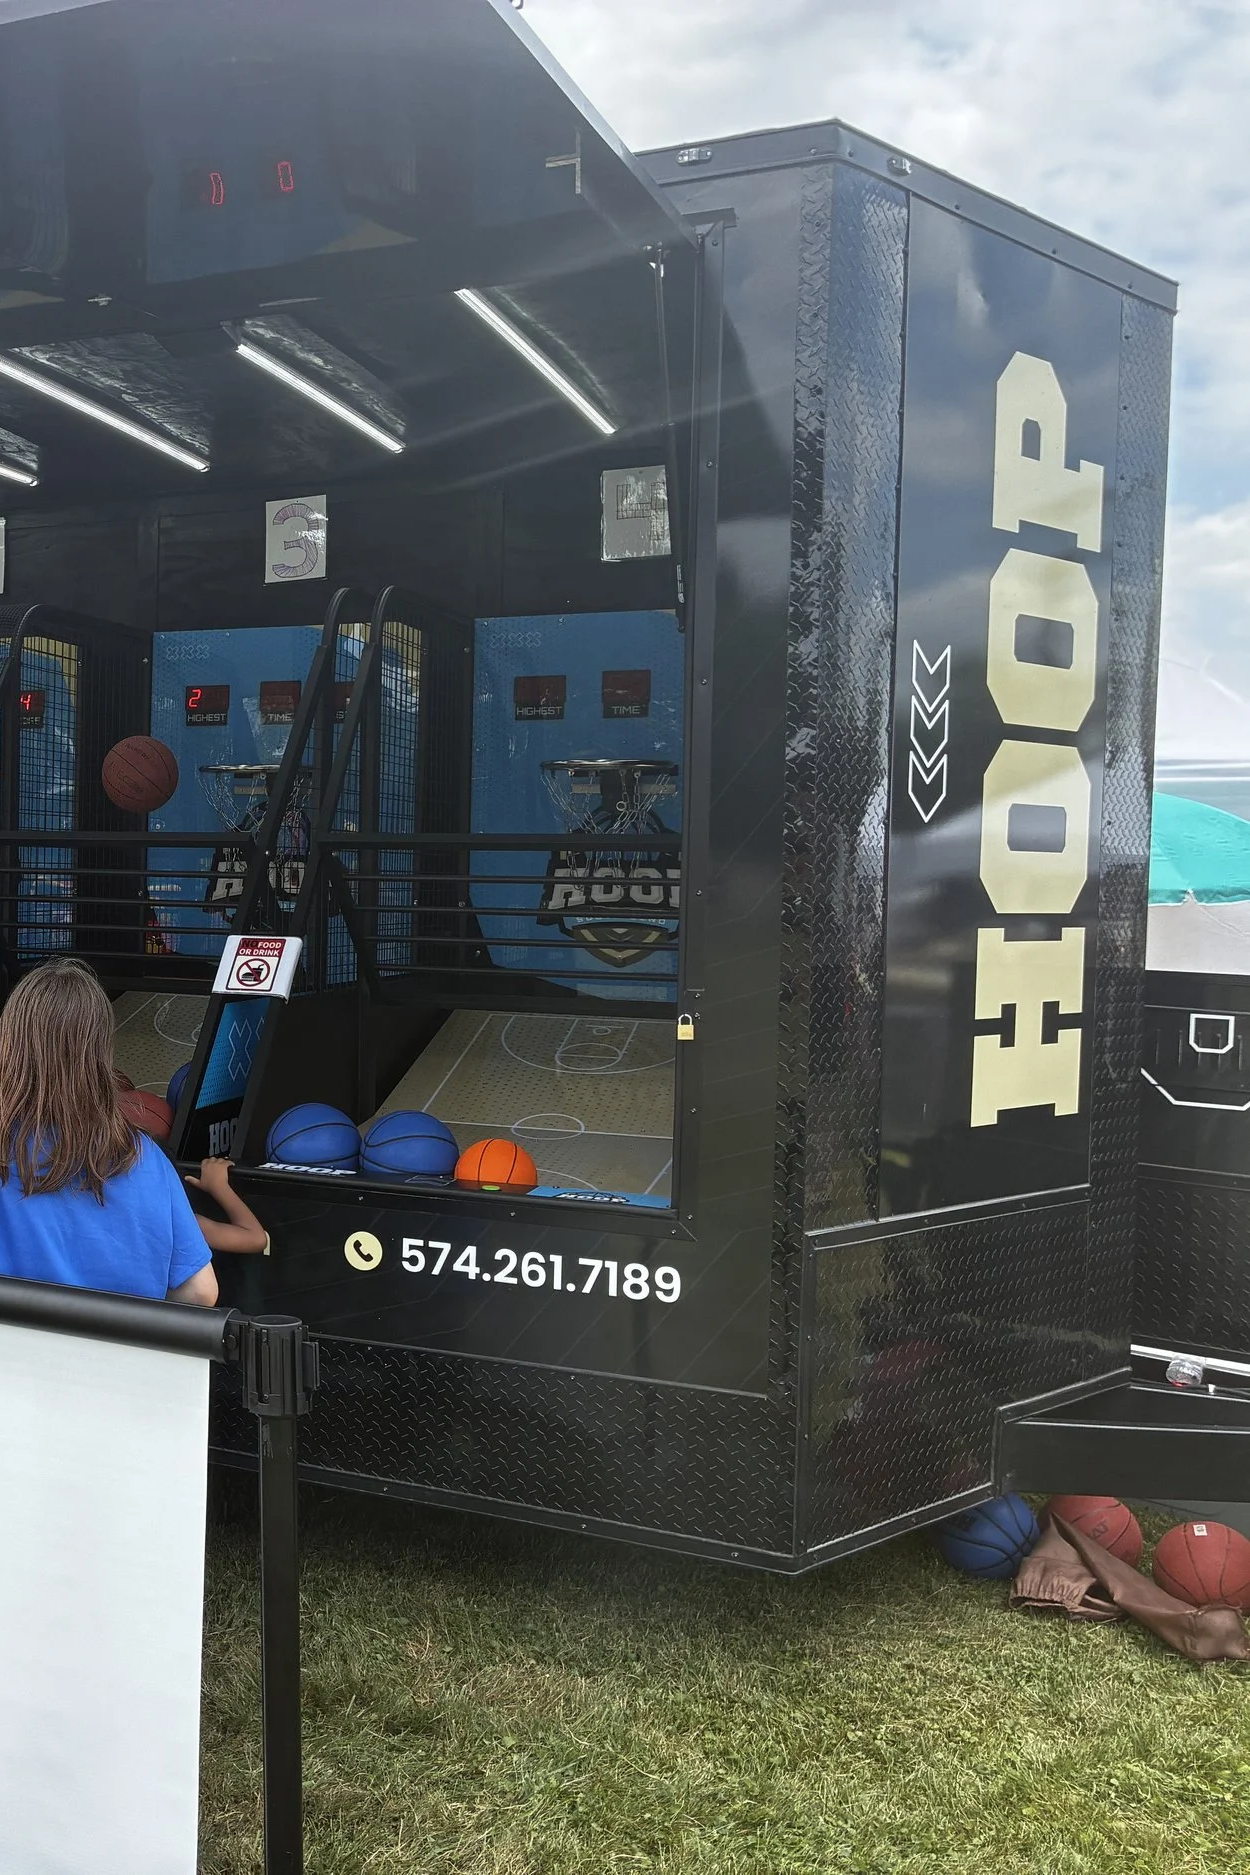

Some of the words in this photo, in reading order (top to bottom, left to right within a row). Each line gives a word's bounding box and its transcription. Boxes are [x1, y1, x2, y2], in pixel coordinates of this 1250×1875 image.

[616, 481, 666, 541] 4
[272, 502, 319, 578] 3
[188, 688, 202, 708] 2
[187, 713, 226, 722] HIGHEST
[267, 712, 293, 721] TIME
[516, 706, 562, 716] HIGHEST
[612, 706, 641, 715] TIME
[970, 351, 1104, 1127] HOOP
[253, 948, 280, 956] DRINK
[258, 941, 282, 949] FOOD
[209, 1117, 239, 1157] HOO
[257, 1162, 357, 1176] HOOP
[401, 1237, 681, 1303] 574.261.7189
